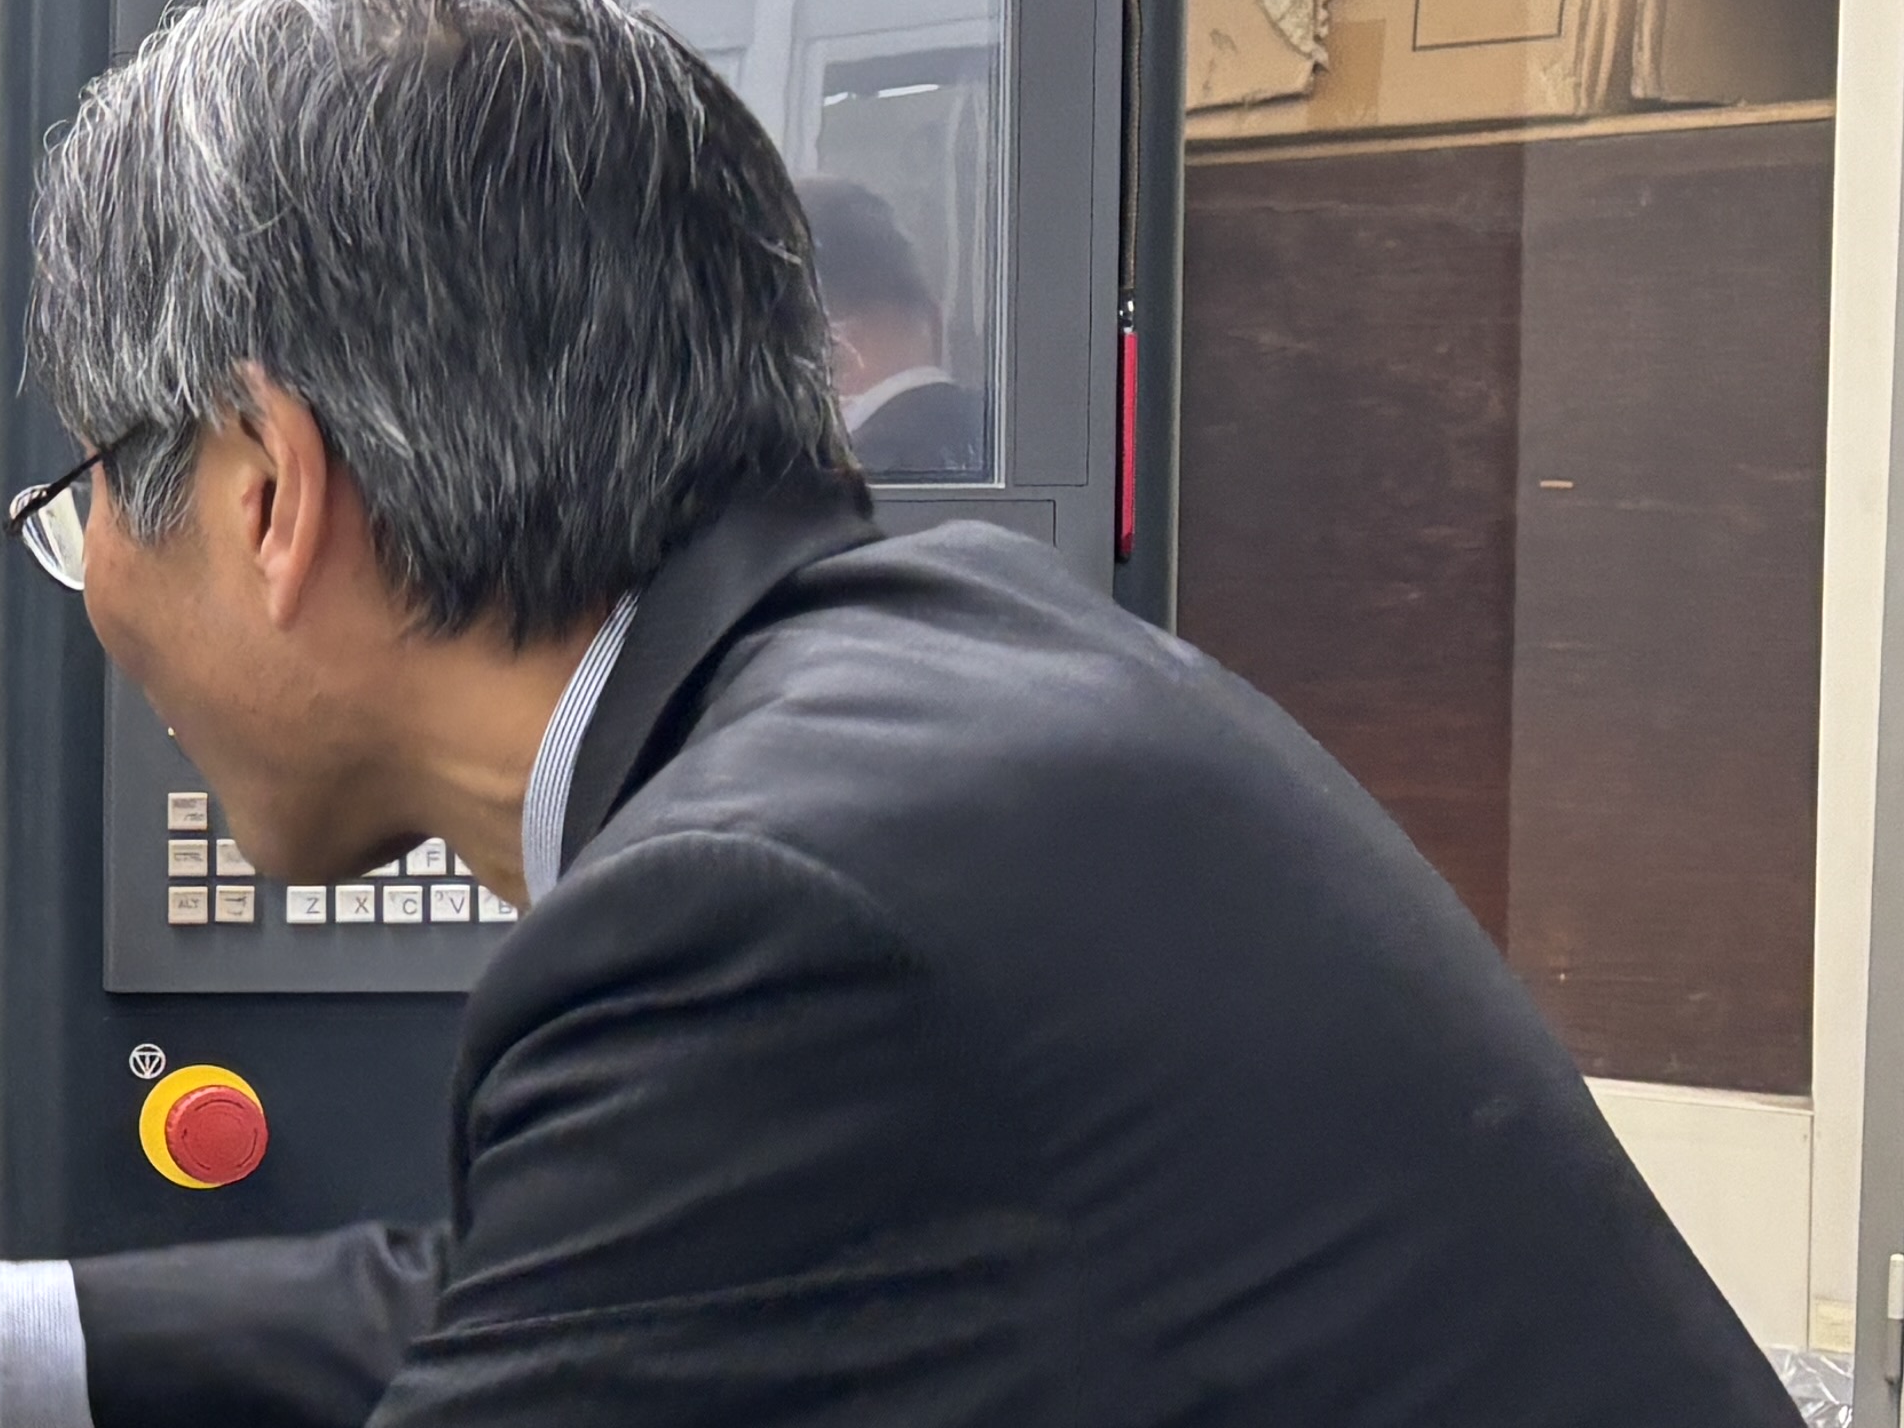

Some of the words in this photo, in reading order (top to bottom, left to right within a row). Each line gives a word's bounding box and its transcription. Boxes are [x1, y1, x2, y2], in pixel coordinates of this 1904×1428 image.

[426, 850, 441, 868] F
[305, 897, 322, 915] Z
[354, 897, 370, 915] X
[450, 897, 466, 915] V
